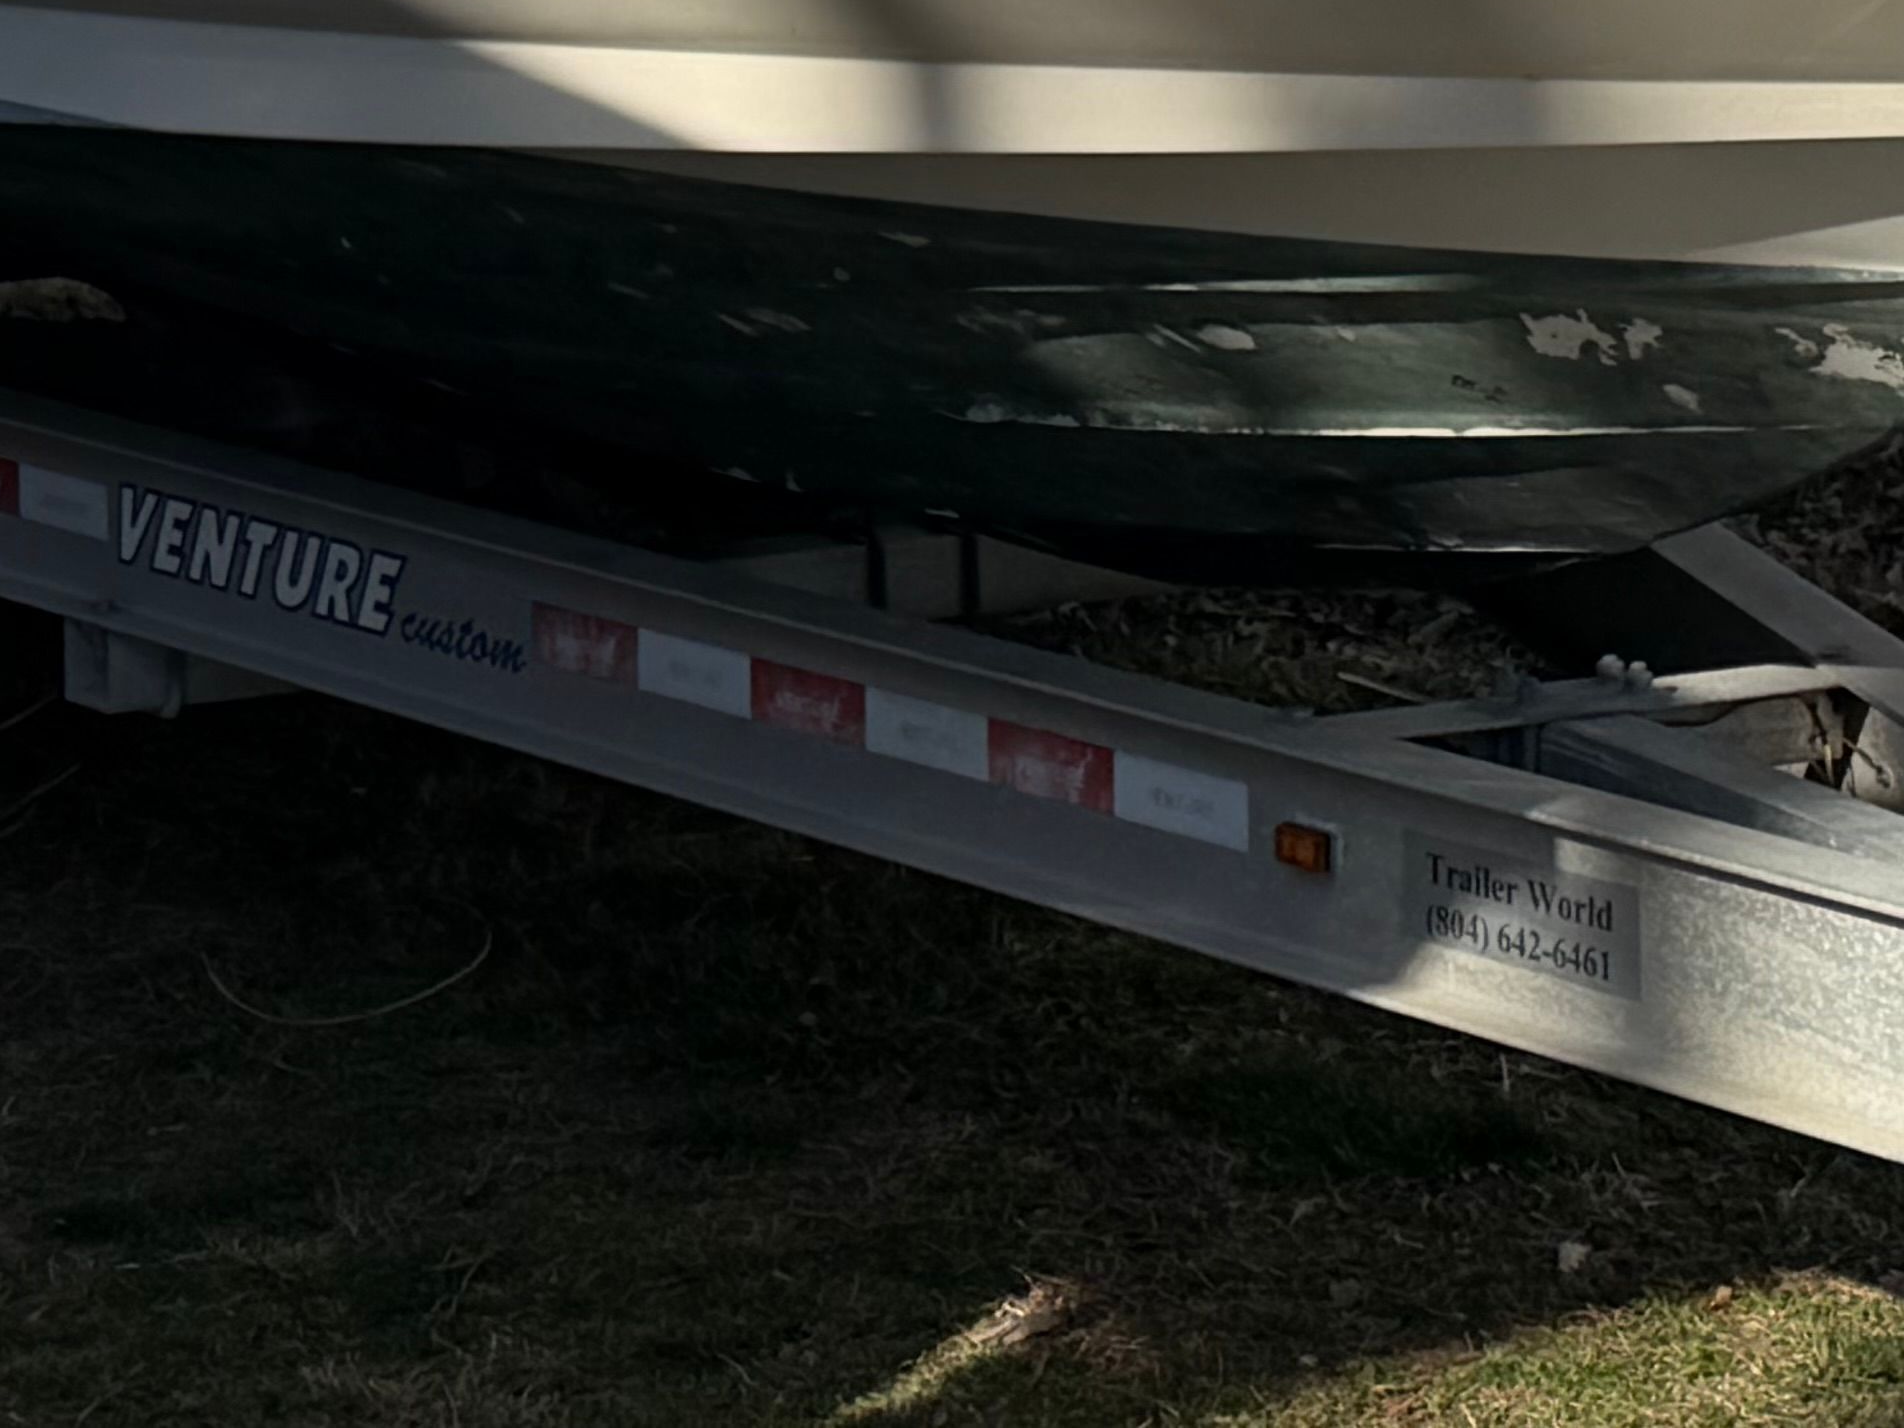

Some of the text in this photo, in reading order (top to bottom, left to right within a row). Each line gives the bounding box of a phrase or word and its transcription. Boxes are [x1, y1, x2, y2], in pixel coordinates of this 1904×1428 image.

[118, 483, 528, 674] VENTURE custom
[1426, 853, 1613, 932] Trailer World
[1427, 905, 1610, 981] (804) 642-6461
